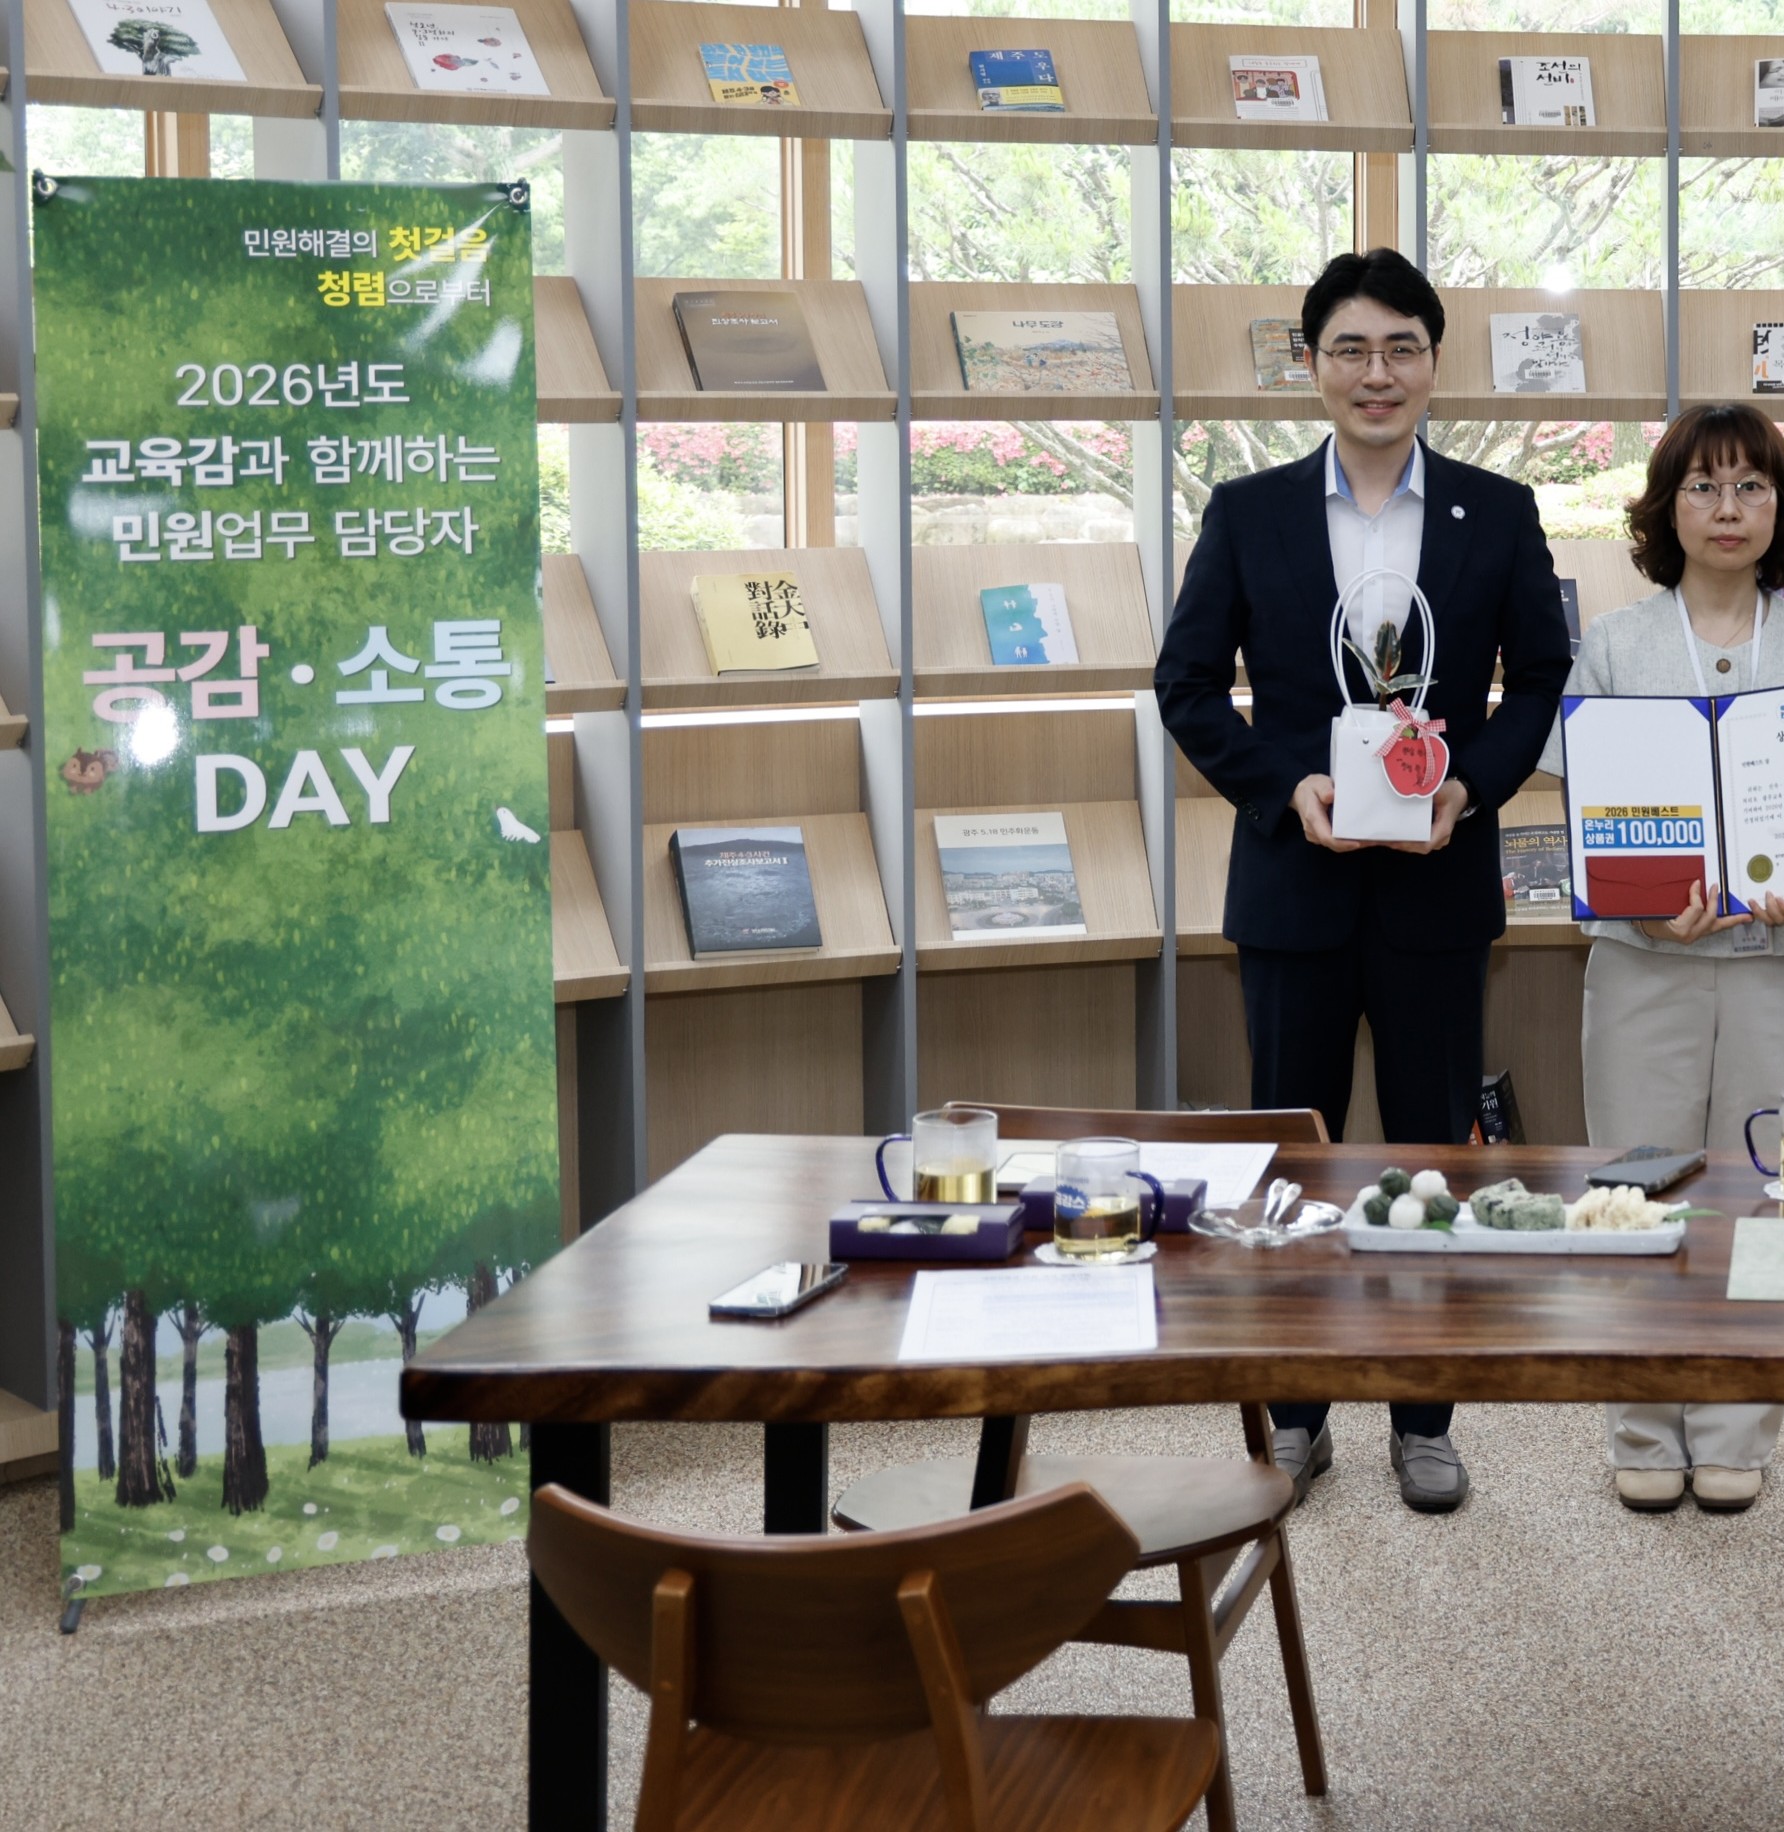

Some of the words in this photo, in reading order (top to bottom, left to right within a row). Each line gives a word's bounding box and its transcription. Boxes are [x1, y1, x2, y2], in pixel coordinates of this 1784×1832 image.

[1535, 60, 1581, 73] 조선의
[1535, 73, 1570, 86] 선비
[243, 228, 378, 259] 민원해결의
[388, 226, 491, 262] 첫걸음
[316, 270, 491, 307] 청렴으로부터
[1012, 319, 1037, 329] 나무
[174, 360, 410, 408] 2026년도
[82, 436, 289, 487] 교육감과
[306, 433, 501, 485] 함께하는
[112, 509, 315, 563] 민원업무
[334, 505, 480, 558] 담당자
[195, 744, 417, 833] DAY
[1605, 807, 1628, 817] 2026
[1631, 806, 1679, 817] 민원베스트
[1585, 819, 1614, 831] 온누리
[1618, 820, 1701, 846] 100,000
[1543, 835, 1569, 847] 역사
[1585, 833, 1615, 845] 상품권
